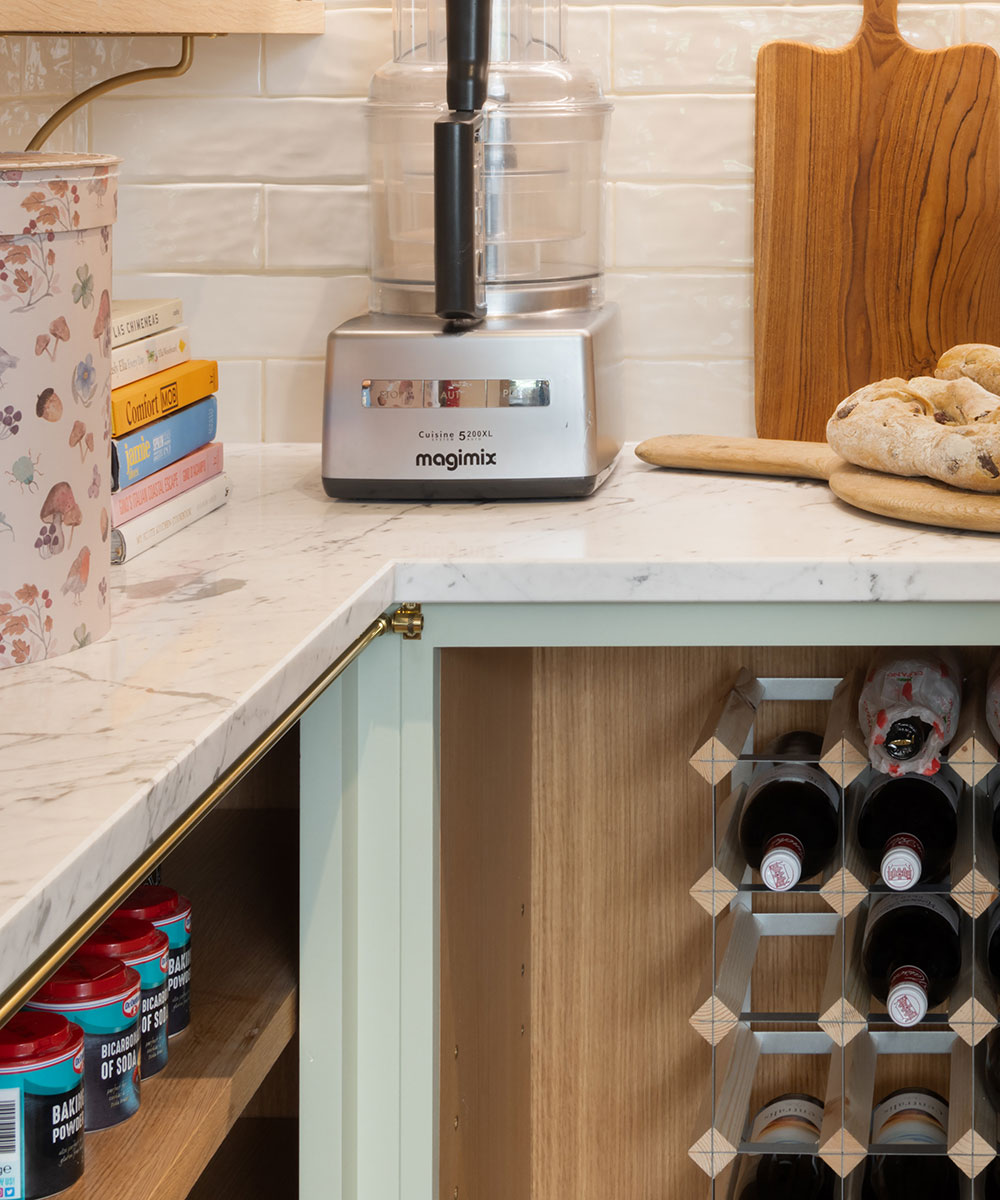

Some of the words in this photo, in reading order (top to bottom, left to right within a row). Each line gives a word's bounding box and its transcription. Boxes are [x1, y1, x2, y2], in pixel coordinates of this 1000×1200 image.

[113, 324, 125, 338] LAS
[126, 313, 160, 330] CHIMENEAS
[125, 392, 160, 426] Comfort
[160, 386, 179, 410] MOB
[418, 430, 455, 439] Cuisine
[125, 435, 151, 476] jamie
[415, 448, 497, 471] magimix
[141, 1015, 151, 1034] OF
[101, 1061, 114, 1081] OF
[116, 1049, 138, 1076] SODA
